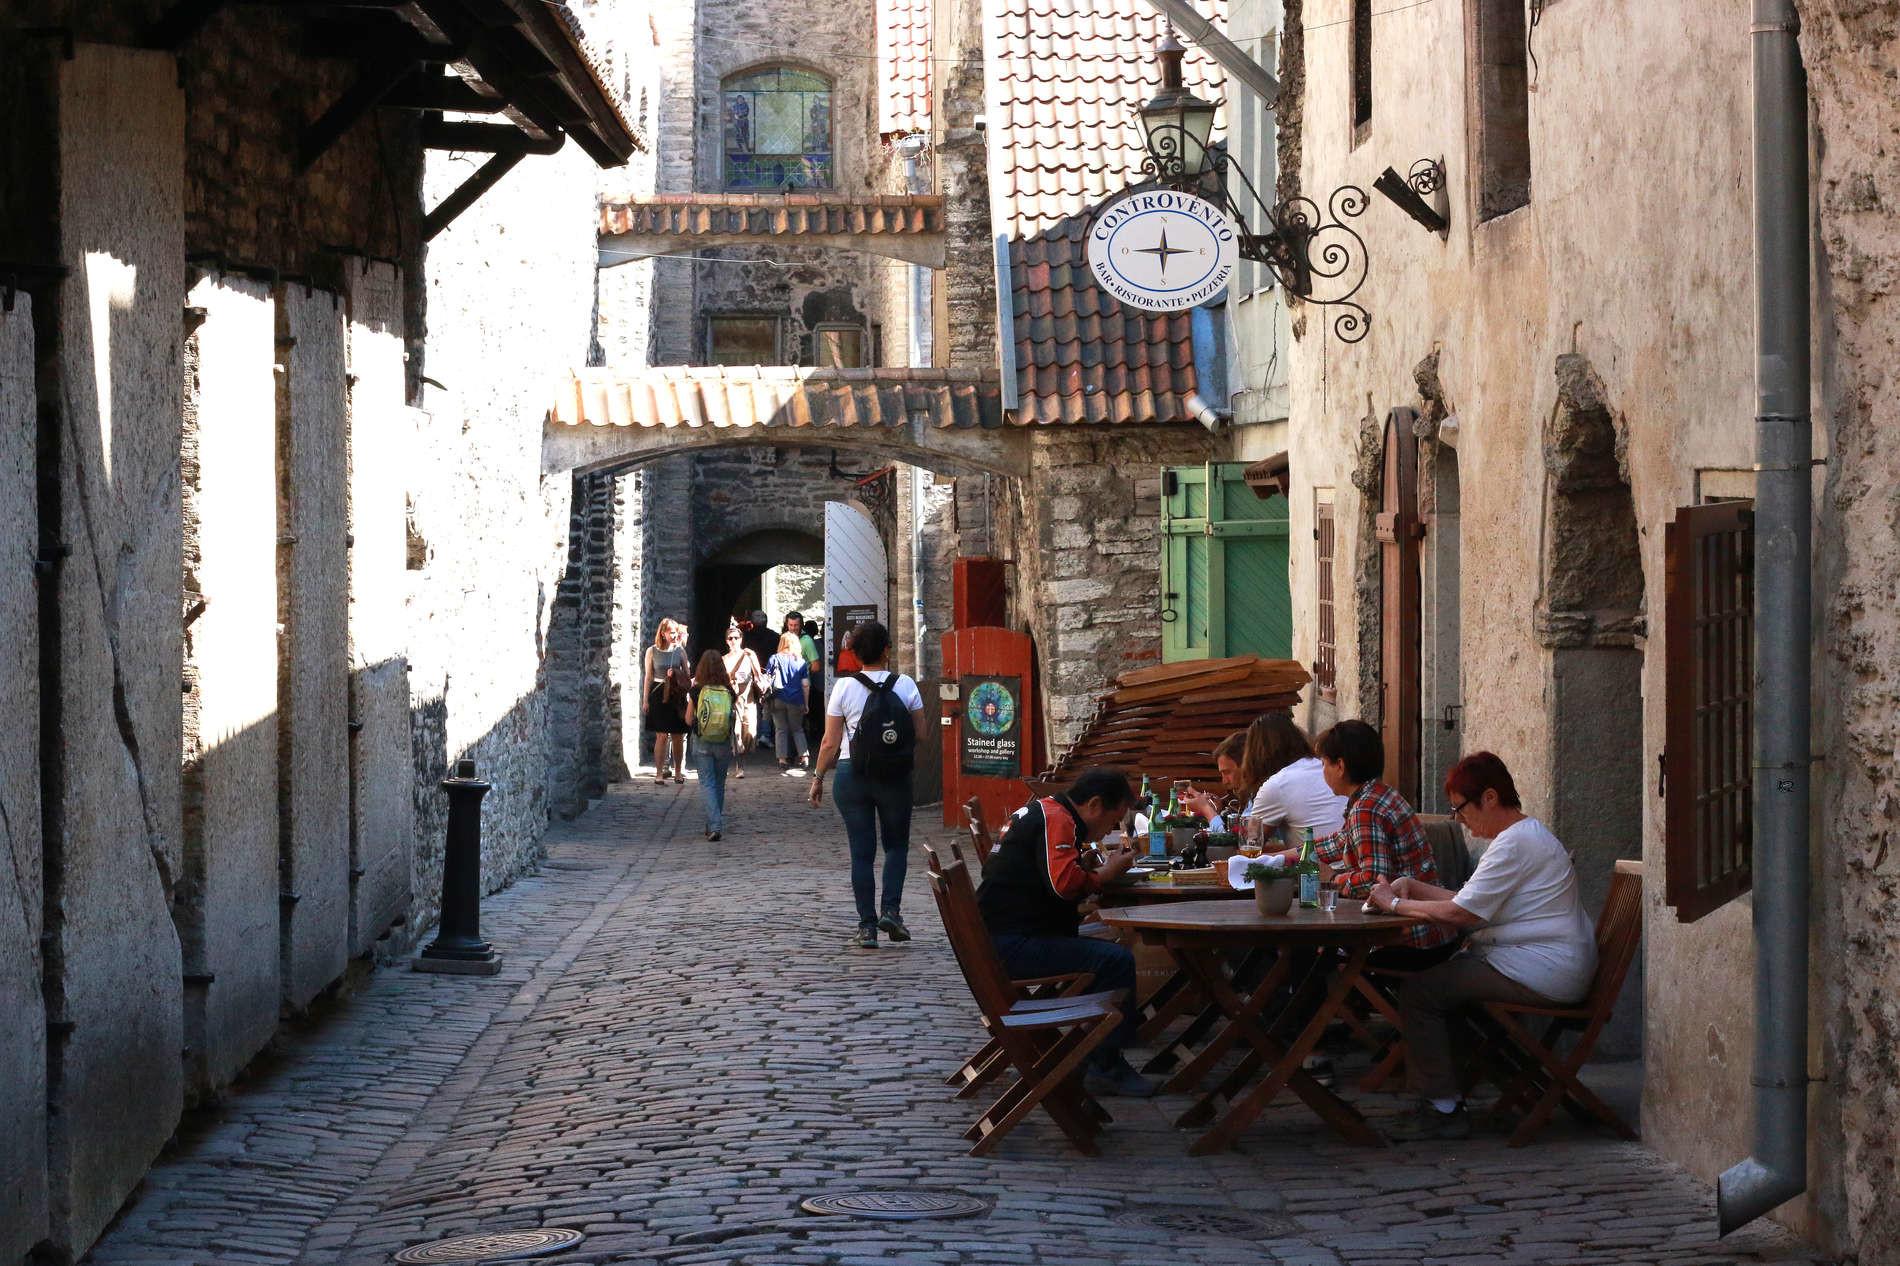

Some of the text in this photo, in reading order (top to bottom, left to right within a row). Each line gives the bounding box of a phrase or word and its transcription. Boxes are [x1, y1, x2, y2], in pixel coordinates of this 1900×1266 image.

[1095, 193, 1233, 242] CONTROVENTO
[1096, 262, 1232, 308] BAR RISTORANTE PIZZERIA
[968, 738, 1016, 748] Stained glass
